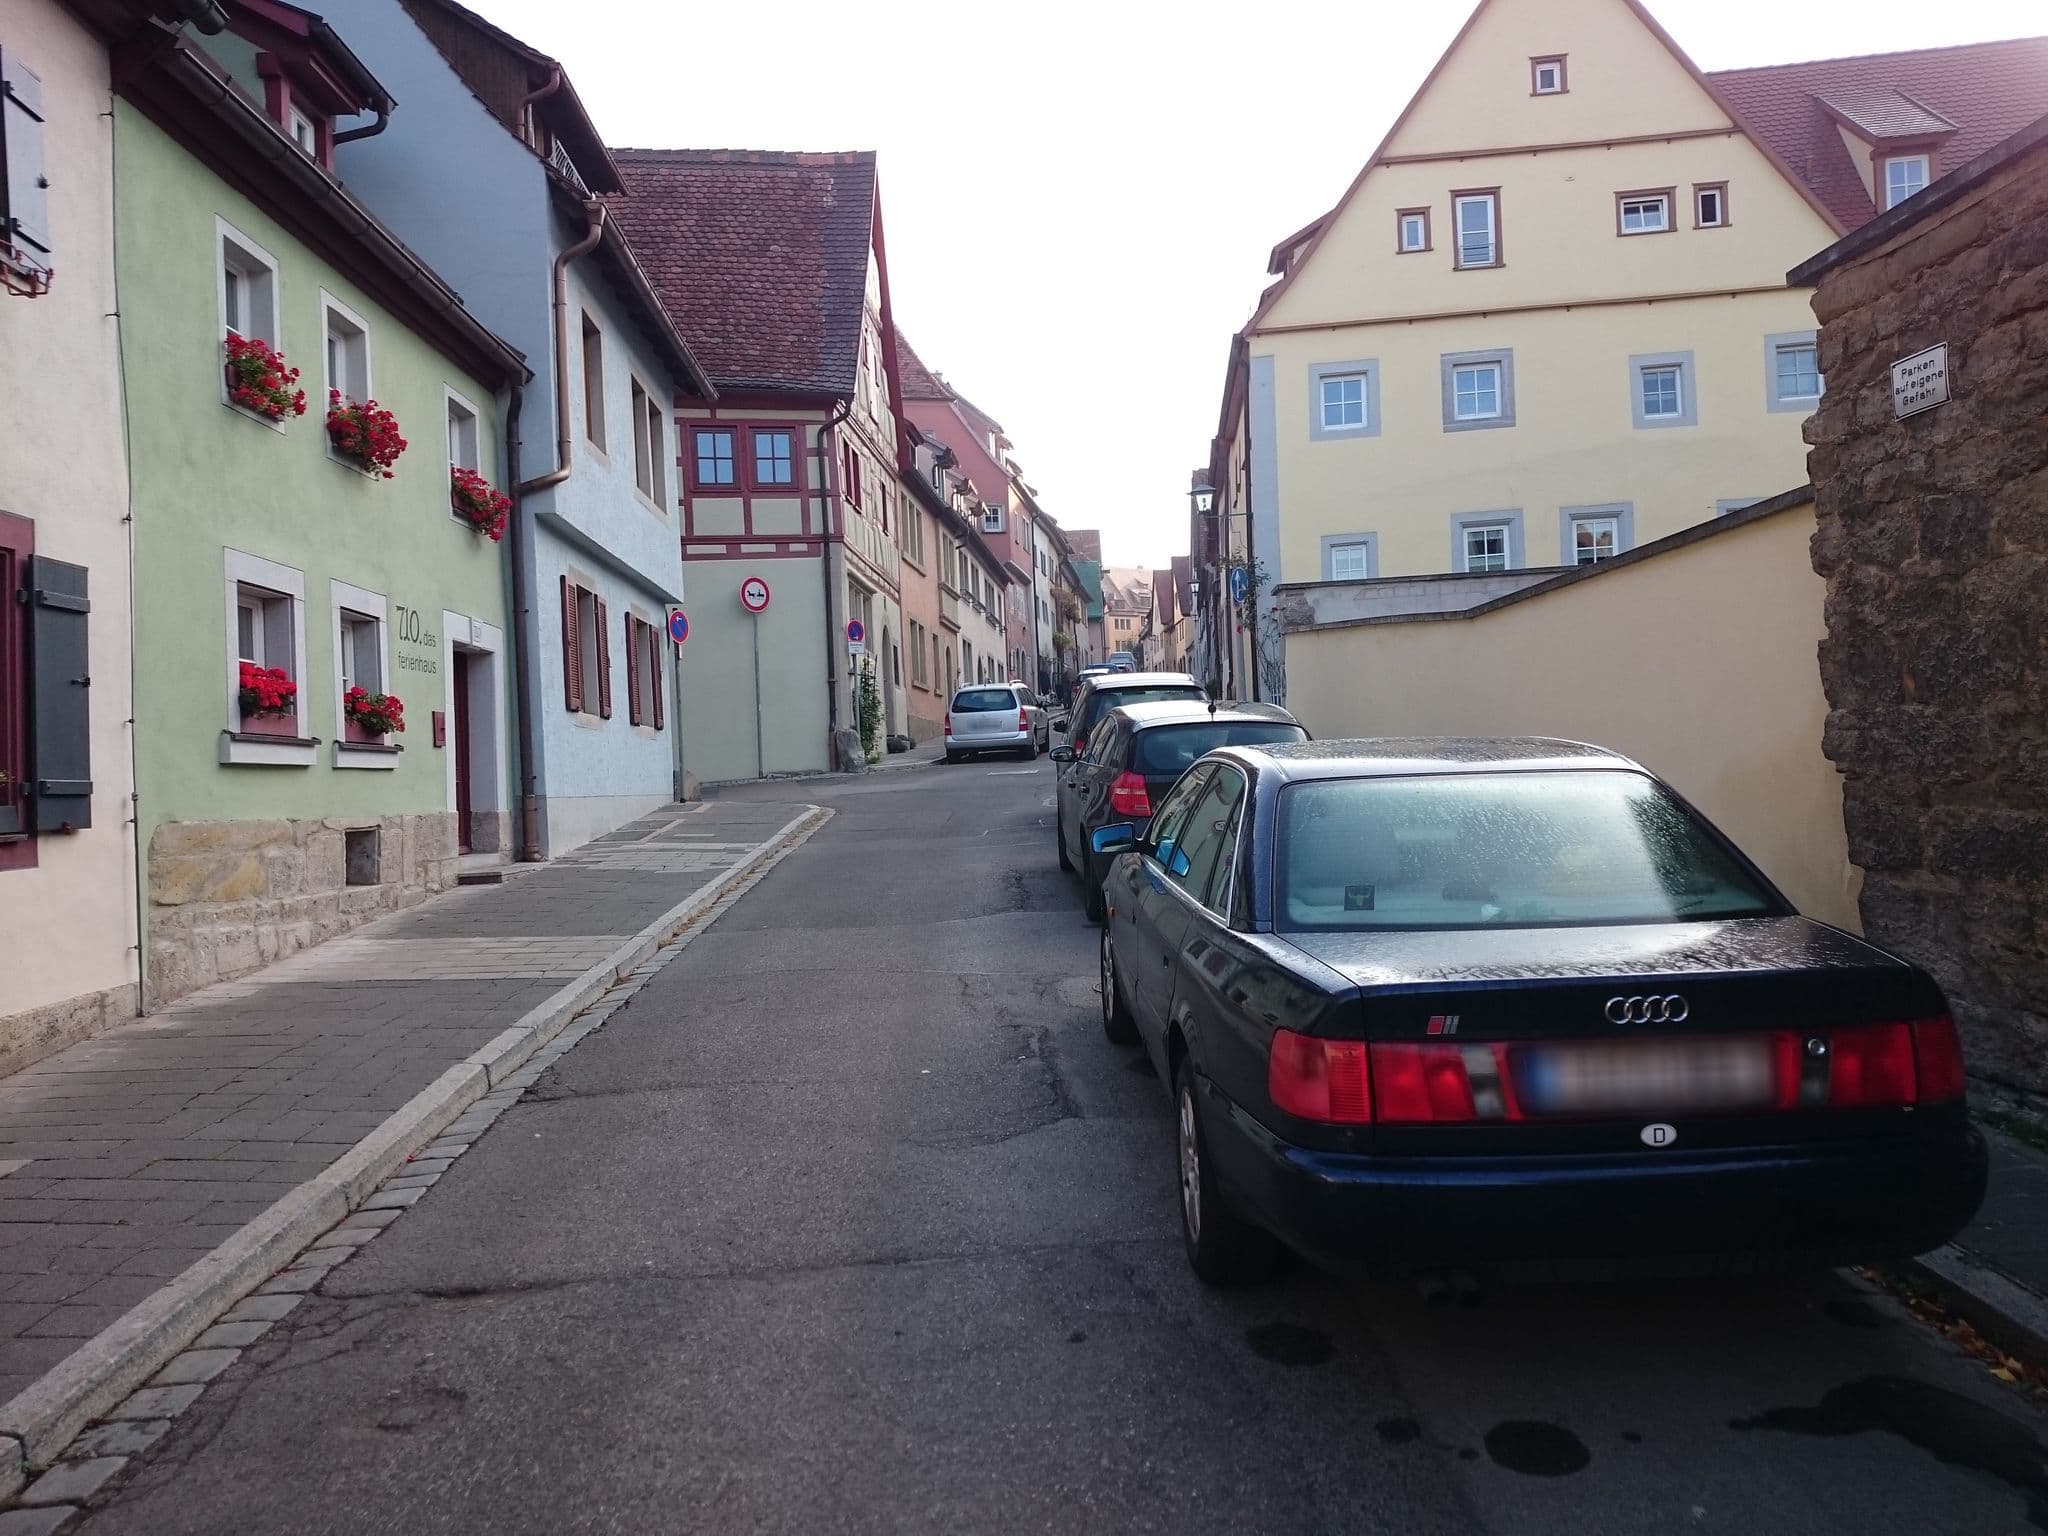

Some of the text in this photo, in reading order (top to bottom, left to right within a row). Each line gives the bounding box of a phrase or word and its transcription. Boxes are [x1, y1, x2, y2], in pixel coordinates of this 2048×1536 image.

[1901, 359, 1936, 379] Parken
[1895, 369, 1944, 395] auf eigene
[1902, 387, 1936, 406] Gefahr
[423, 630, 437, 648] das
[397, 651, 437, 674] ferienhaus
[1653, 1127, 1666, 1144] D
